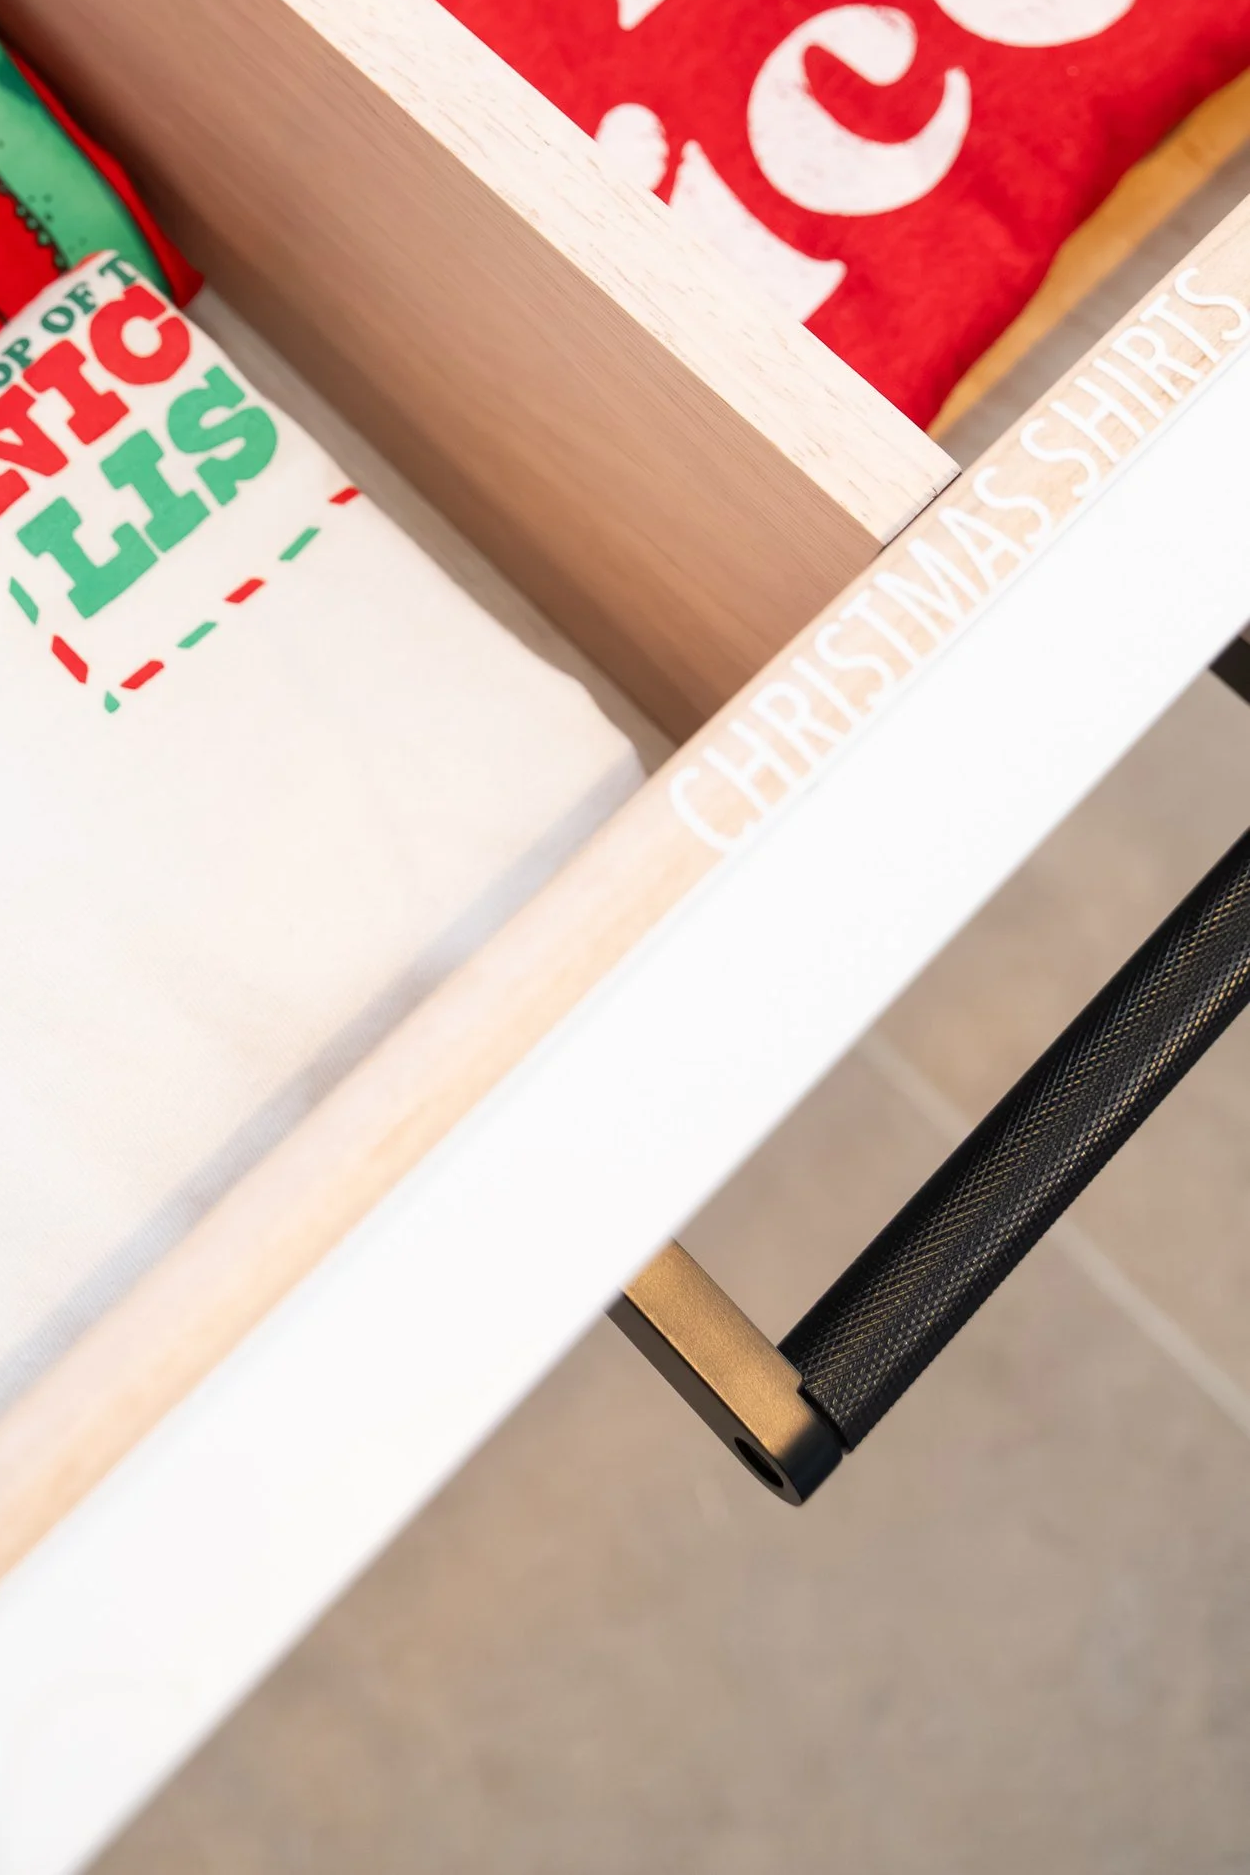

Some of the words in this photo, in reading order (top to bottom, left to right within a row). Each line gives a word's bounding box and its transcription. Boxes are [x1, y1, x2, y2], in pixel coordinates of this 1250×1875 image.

[40, 281, 97, 335] OF
[15, 365, 278, 619] LIS
[668, 466, 1052, 854] CHRISTMAS
[1019, 266, 1250, 497] SHIRTS
